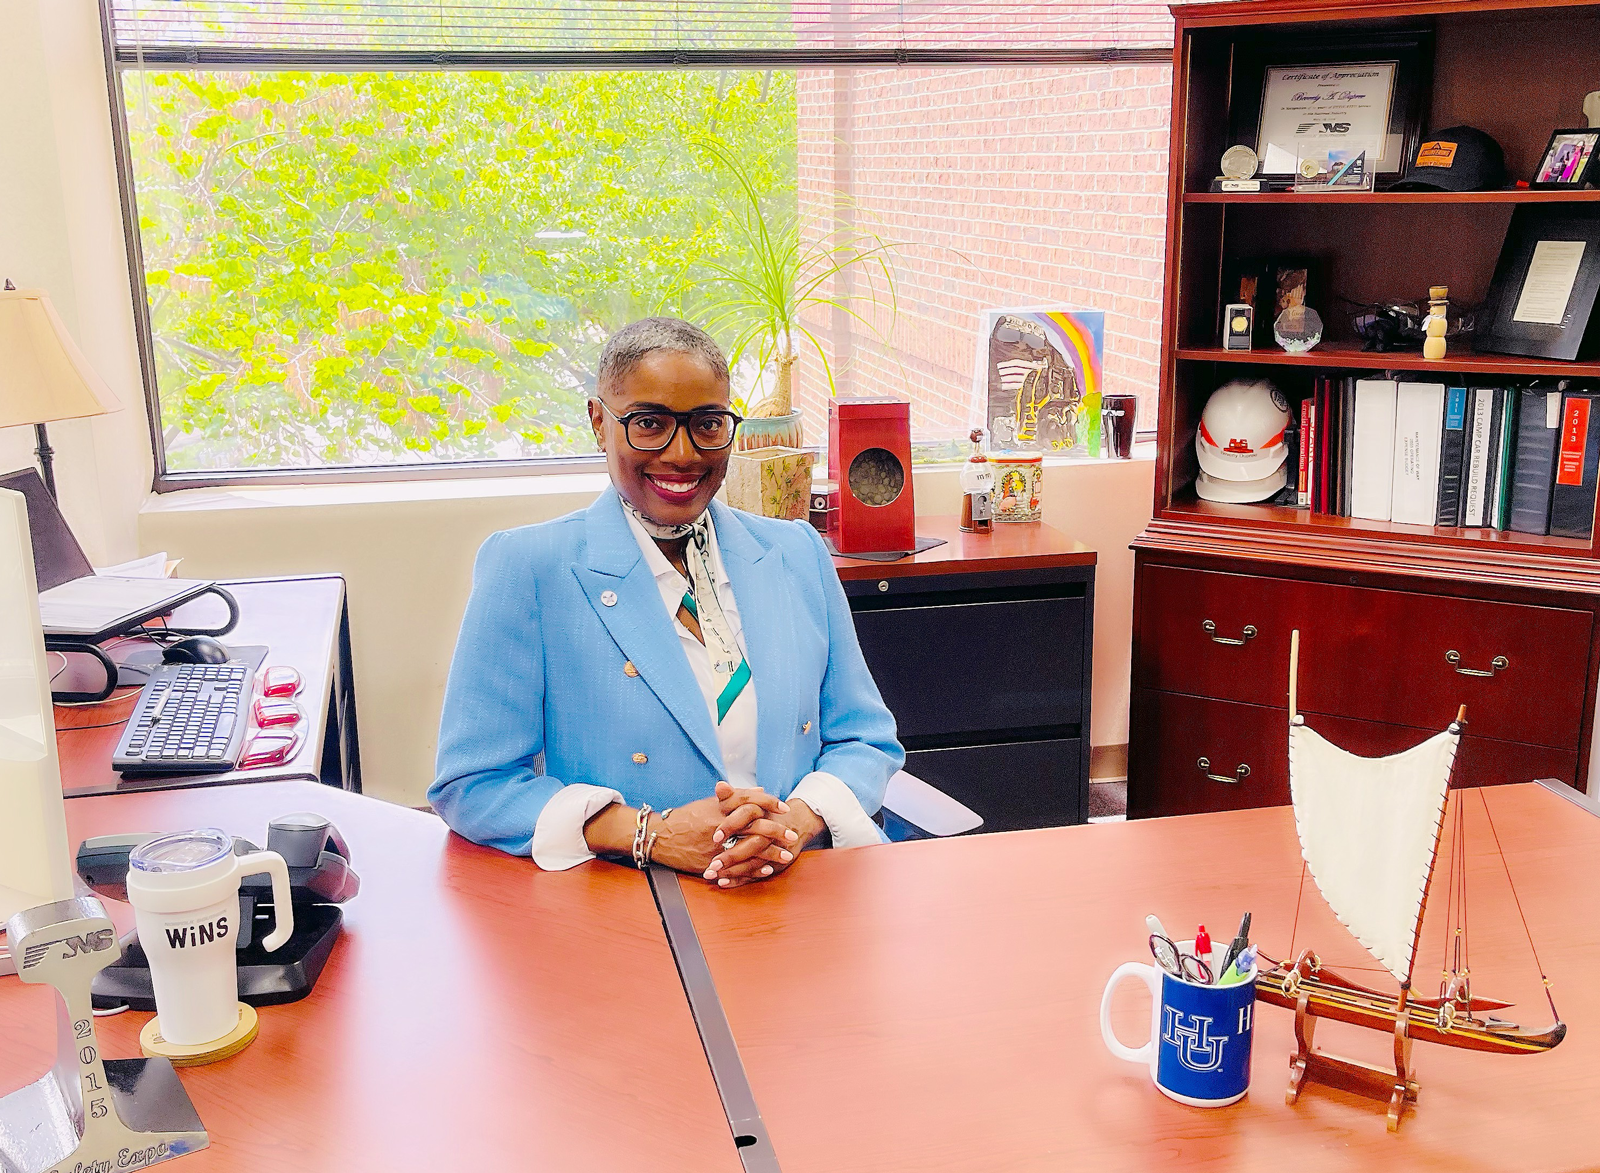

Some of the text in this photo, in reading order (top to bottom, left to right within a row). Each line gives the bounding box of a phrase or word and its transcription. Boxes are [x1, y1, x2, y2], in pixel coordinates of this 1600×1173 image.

[1570, 410, 1579, 442] 2013
[1468, 398, 1485, 517] 2013 CAMP CAR REBUILD REQUEST
[165, 917, 228, 949] WiNS
[74, 1019, 108, 1118] 2015
[117, 1142, 169, 1168] Expo
